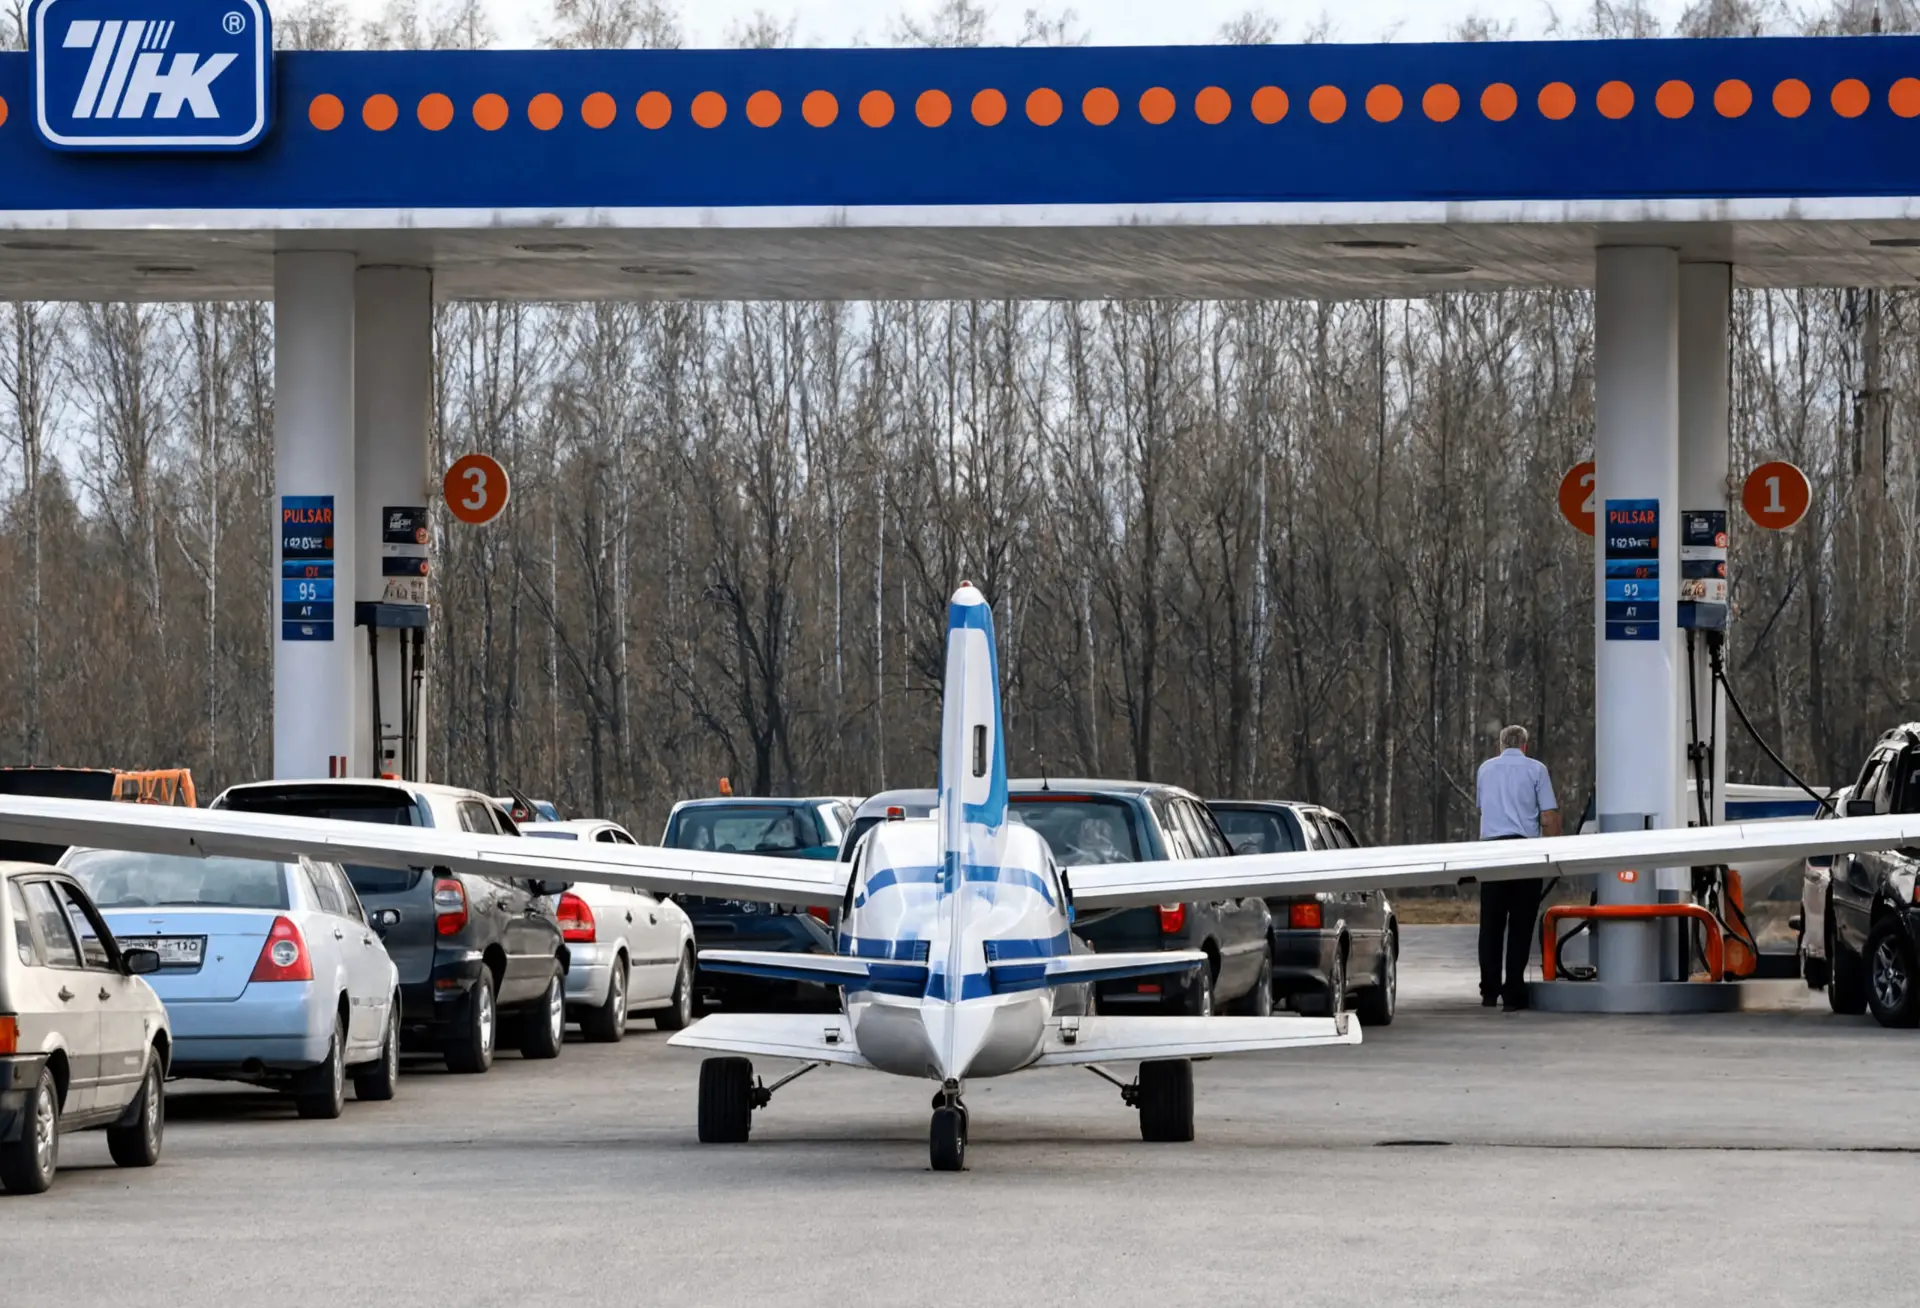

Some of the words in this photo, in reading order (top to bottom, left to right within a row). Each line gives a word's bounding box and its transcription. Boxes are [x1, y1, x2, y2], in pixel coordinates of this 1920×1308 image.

[462, 466, 487, 511] 3
[1580, 473, 1595, 512] 2
[1763, 476, 1785, 512] 1
[283, 508, 332, 524] PULSAR
[1610, 510, 1656, 524] PULSAR
[299, 582, 317, 601] 95
